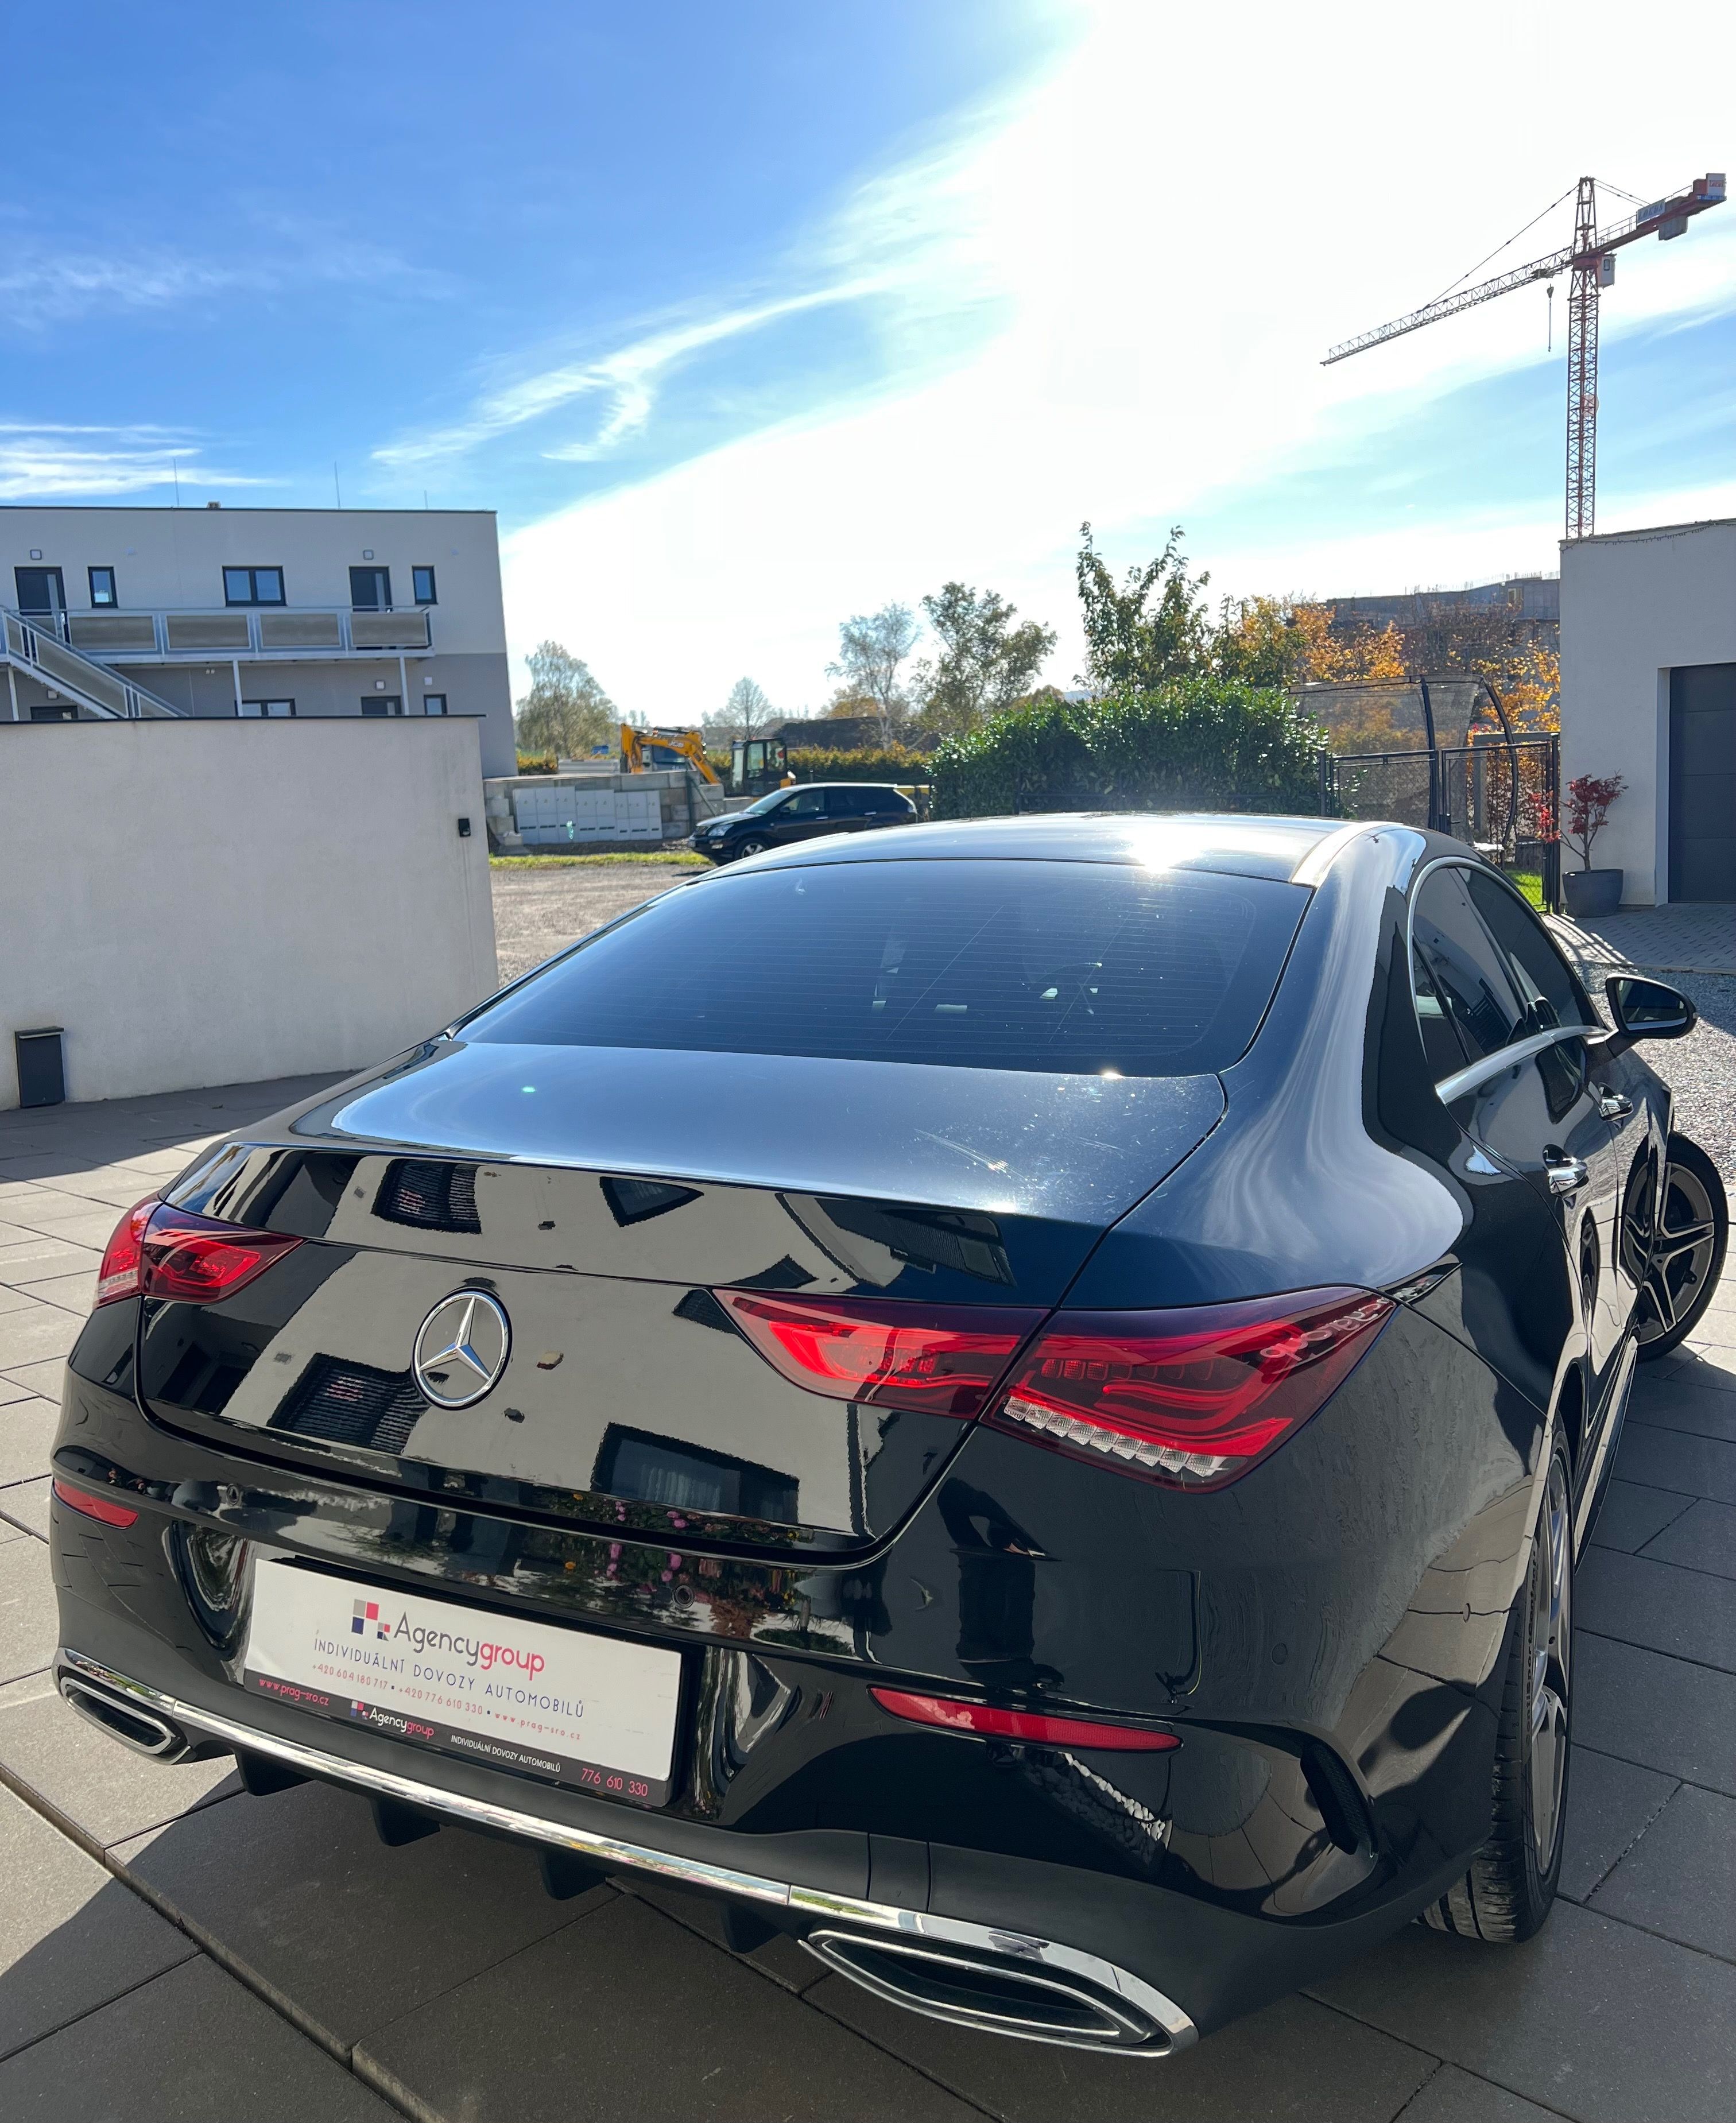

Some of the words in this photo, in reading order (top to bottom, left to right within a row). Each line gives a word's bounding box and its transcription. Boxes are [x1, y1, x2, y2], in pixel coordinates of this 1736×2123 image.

[394, 1611, 545, 1680] Agencygroup
[259, 1677, 330, 1706] www.prag-sro.cz
[315, 1638, 405, 1673] INDIVIDUÁLNÍ
[413, 1664, 475, 1690] DOVOZY
[485, 1683, 583, 1717] AUTOMOBILŮ
[313, 1664, 334, 1675] +420
[336, 1667, 354, 1681] 604
[357, 1674, 371, 1686] 180
[374, 1678, 388, 1690] 717
[398, 1687, 423, 1699] +420
[425, 1692, 443, 1704] 776
[446, 1698, 462, 1710] 610
[465, 1702, 483, 1715] 330
[495, 1712, 580, 1740] www.prag-sro.cz
[369, 1707, 435, 1740] Agencygroup
[451, 1734, 492, 1753] INDIVIDUÁLNÍ
[492, 1746, 518, 1761] DOVOZY
[518, 1754, 561, 1773] AUTOMOBILŮ
[581, 1768, 601, 1784] 776
[606, 1775, 623, 1790] 610
[628, 1780, 648, 1797] 330
